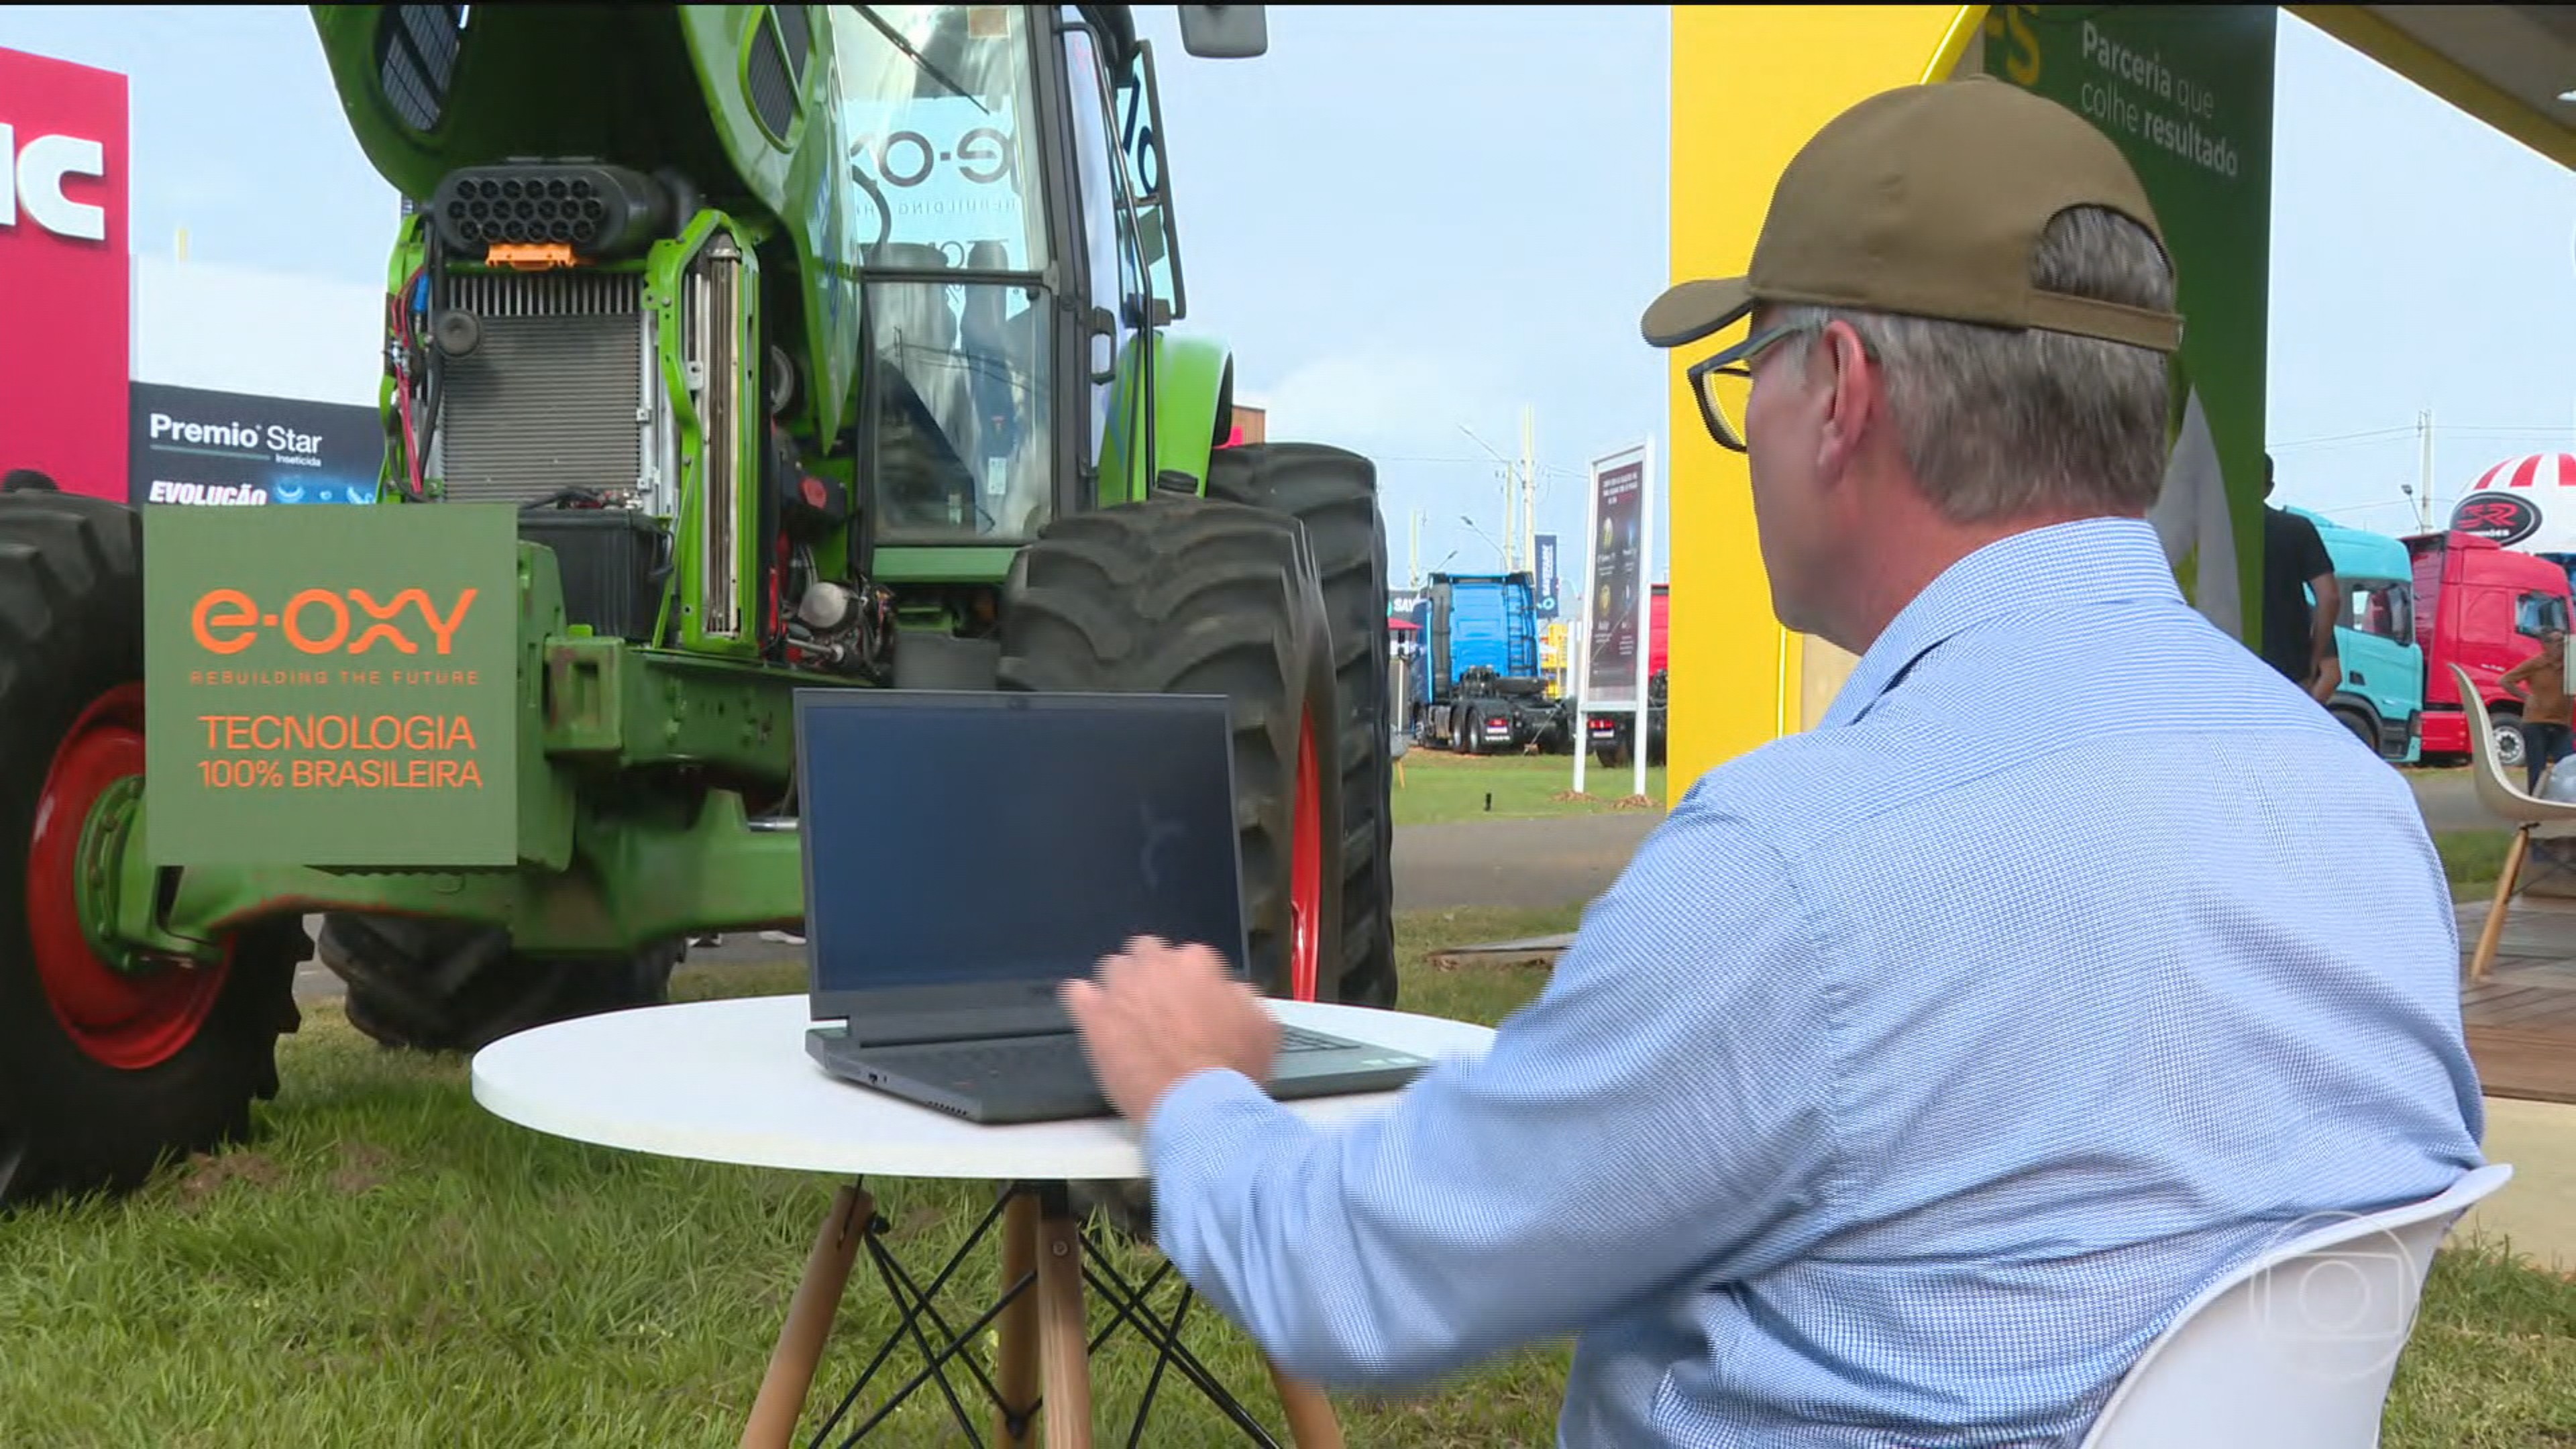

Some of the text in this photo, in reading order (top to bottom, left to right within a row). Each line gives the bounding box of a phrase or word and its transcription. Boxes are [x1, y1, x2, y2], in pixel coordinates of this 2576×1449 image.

[2083, 20, 2214, 119] Parceria que
[2082, 82, 2239, 177] colhe resultado
[267, 425, 323, 454] Star
[275, 453, 322, 468] Inseticida
[190, 671, 480, 686] REBUILDING THE FUTURE
[197, 714, 476, 750] TECNOLOGIA
[197, 759, 484, 788] 100% BRASILEIRA
